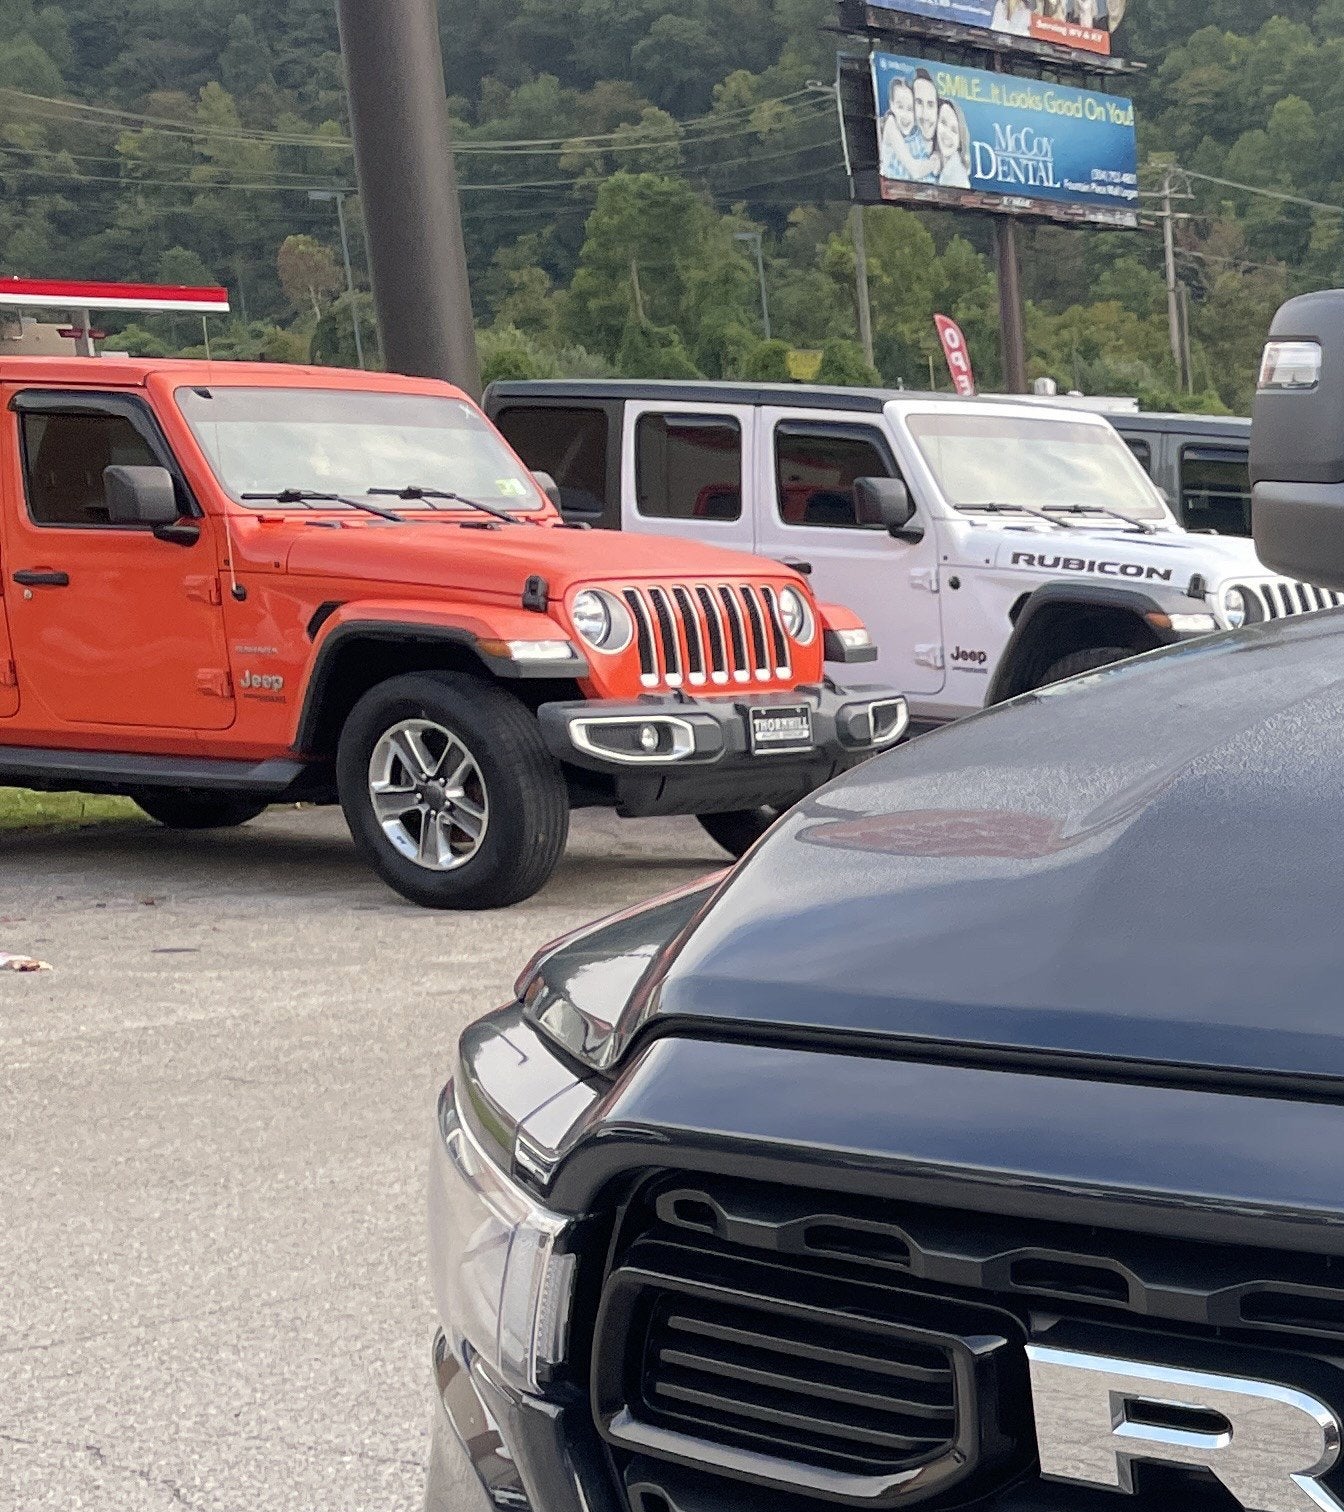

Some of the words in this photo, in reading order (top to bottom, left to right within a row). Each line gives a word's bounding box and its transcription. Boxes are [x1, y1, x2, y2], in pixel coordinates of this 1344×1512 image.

[1003, 84, 1043, 111] Looks
[1043, 91, 1083, 118] Good
[1084, 98, 1106, 122] On
[1106, 100, 1135, 127] You!
[972, 141, 1061, 188] DENTAL
[1011, 552, 1173, 581] RUBICON
[951, 646, 987, 664] Jeep
[240, 669, 284, 692] Jeep
